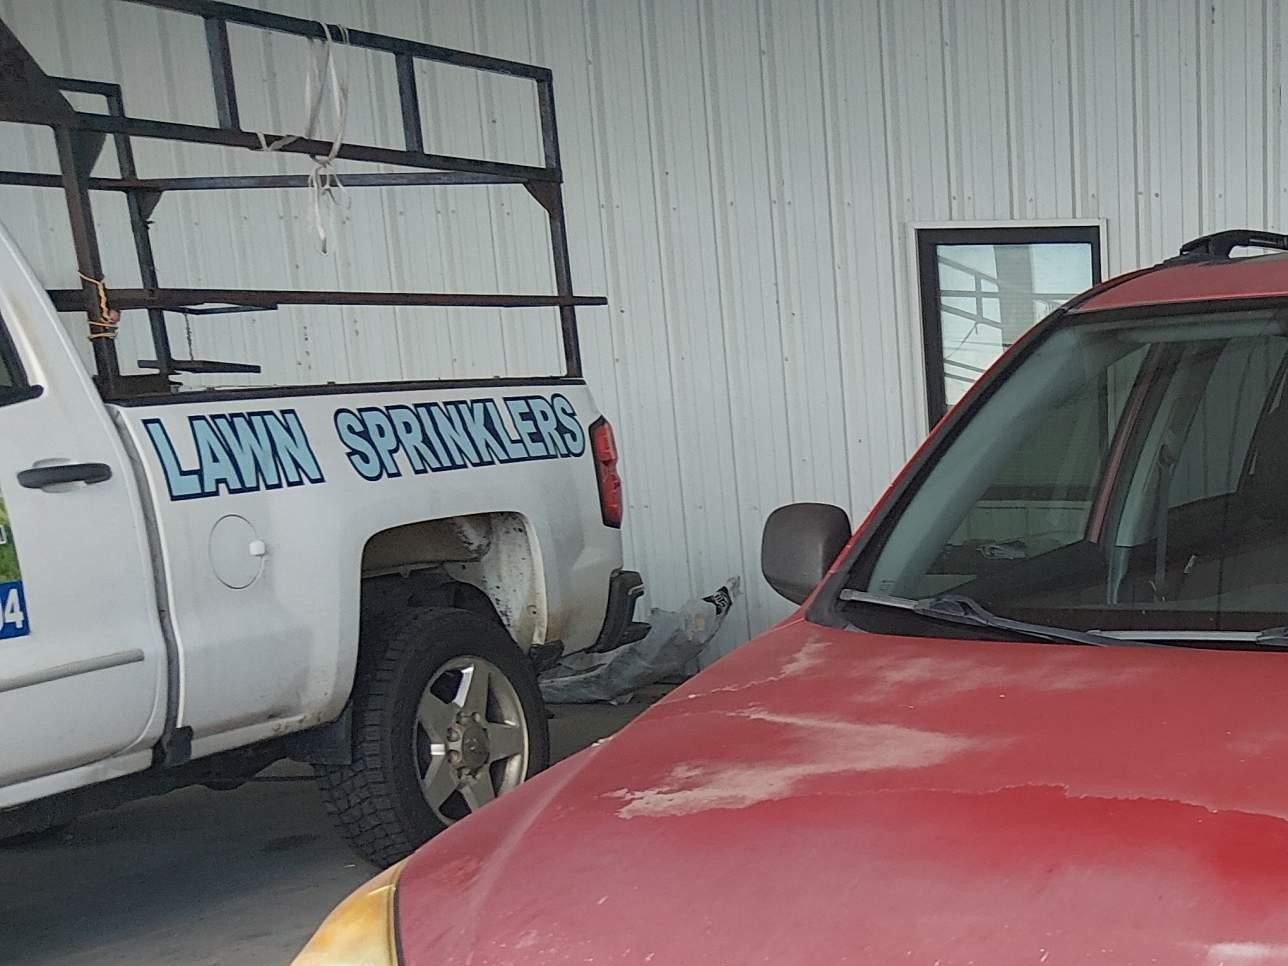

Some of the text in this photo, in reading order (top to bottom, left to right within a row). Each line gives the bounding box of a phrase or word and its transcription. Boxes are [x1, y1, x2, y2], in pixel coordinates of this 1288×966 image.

[141, 393, 587, 502] LAWN SPRINKLERS
[0, 588, 25, 632] 4
